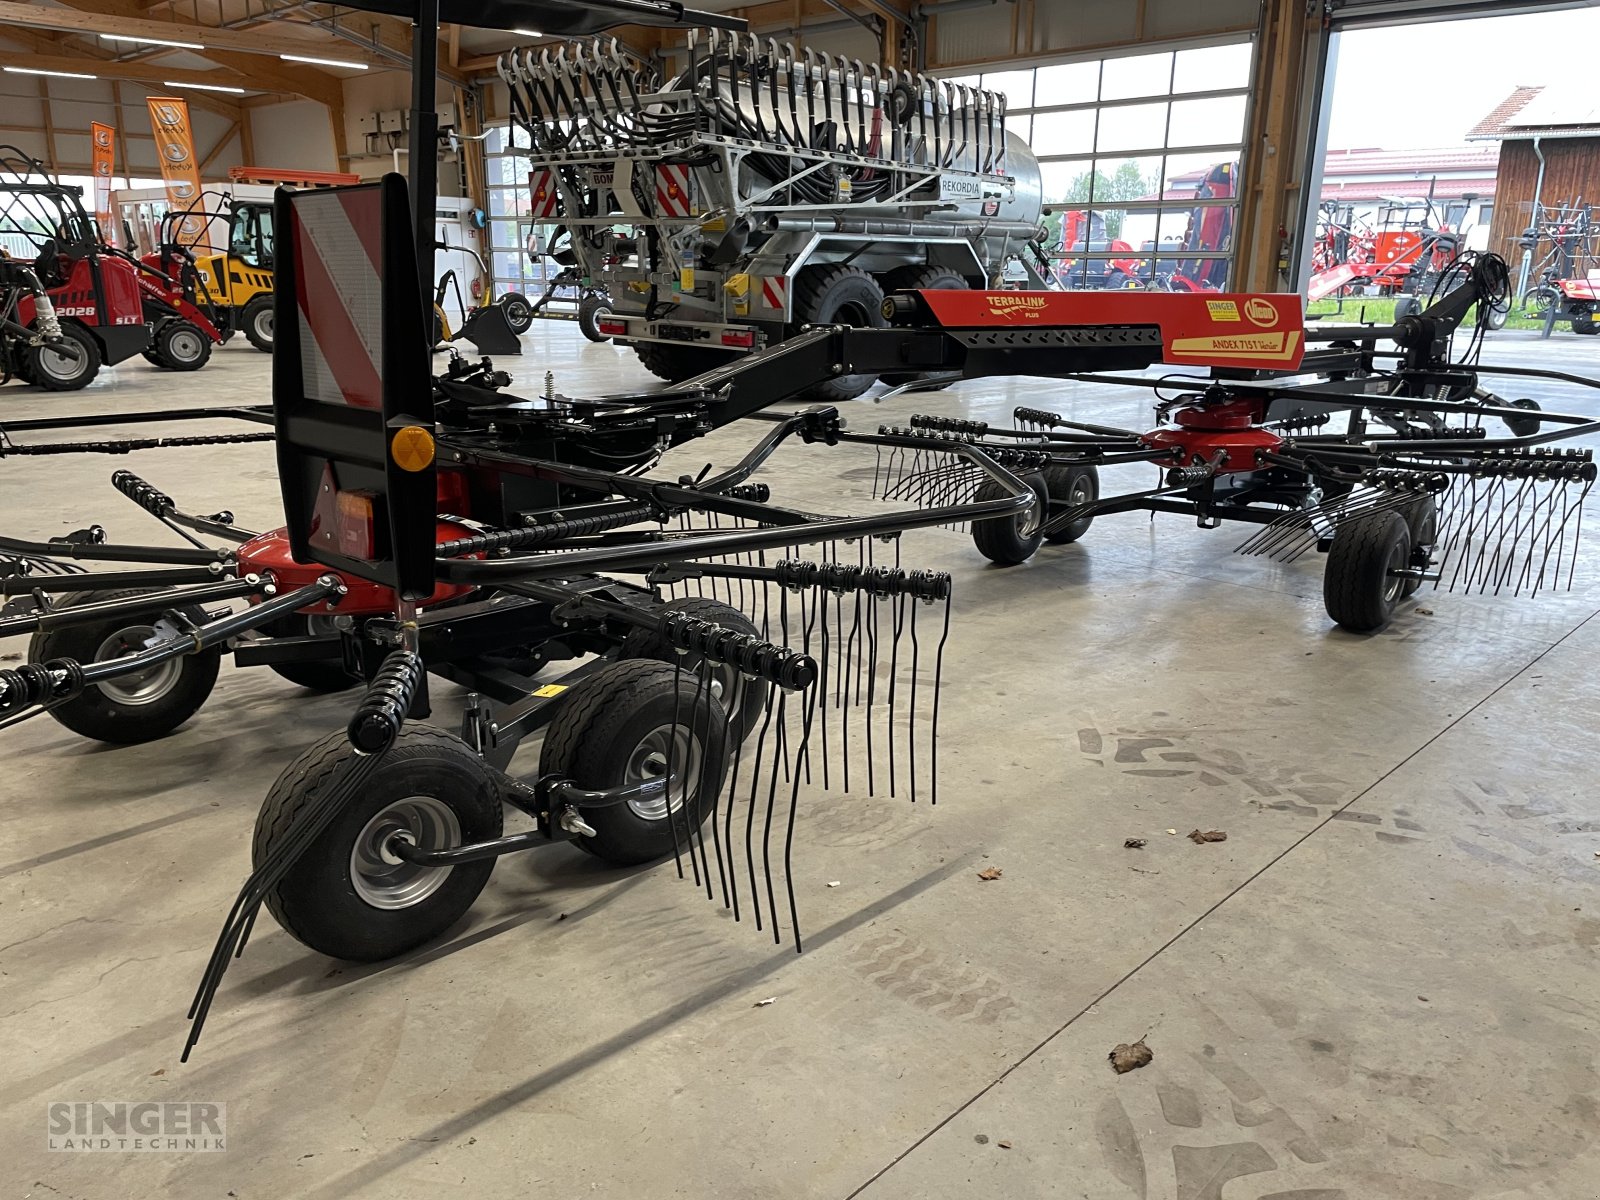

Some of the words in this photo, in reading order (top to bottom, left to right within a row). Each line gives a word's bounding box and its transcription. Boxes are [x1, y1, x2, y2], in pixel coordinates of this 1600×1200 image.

[942, 180, 980, 194] REKORDIA
[986, 296, 1045, 307] TERRALINK
[1208, 302, 1236, 311] SINGER
[56, 307, 95, 317] 2028
[115, 317, 138, 325] SLT
[1212, 340, 1239, 349] ANDEX
